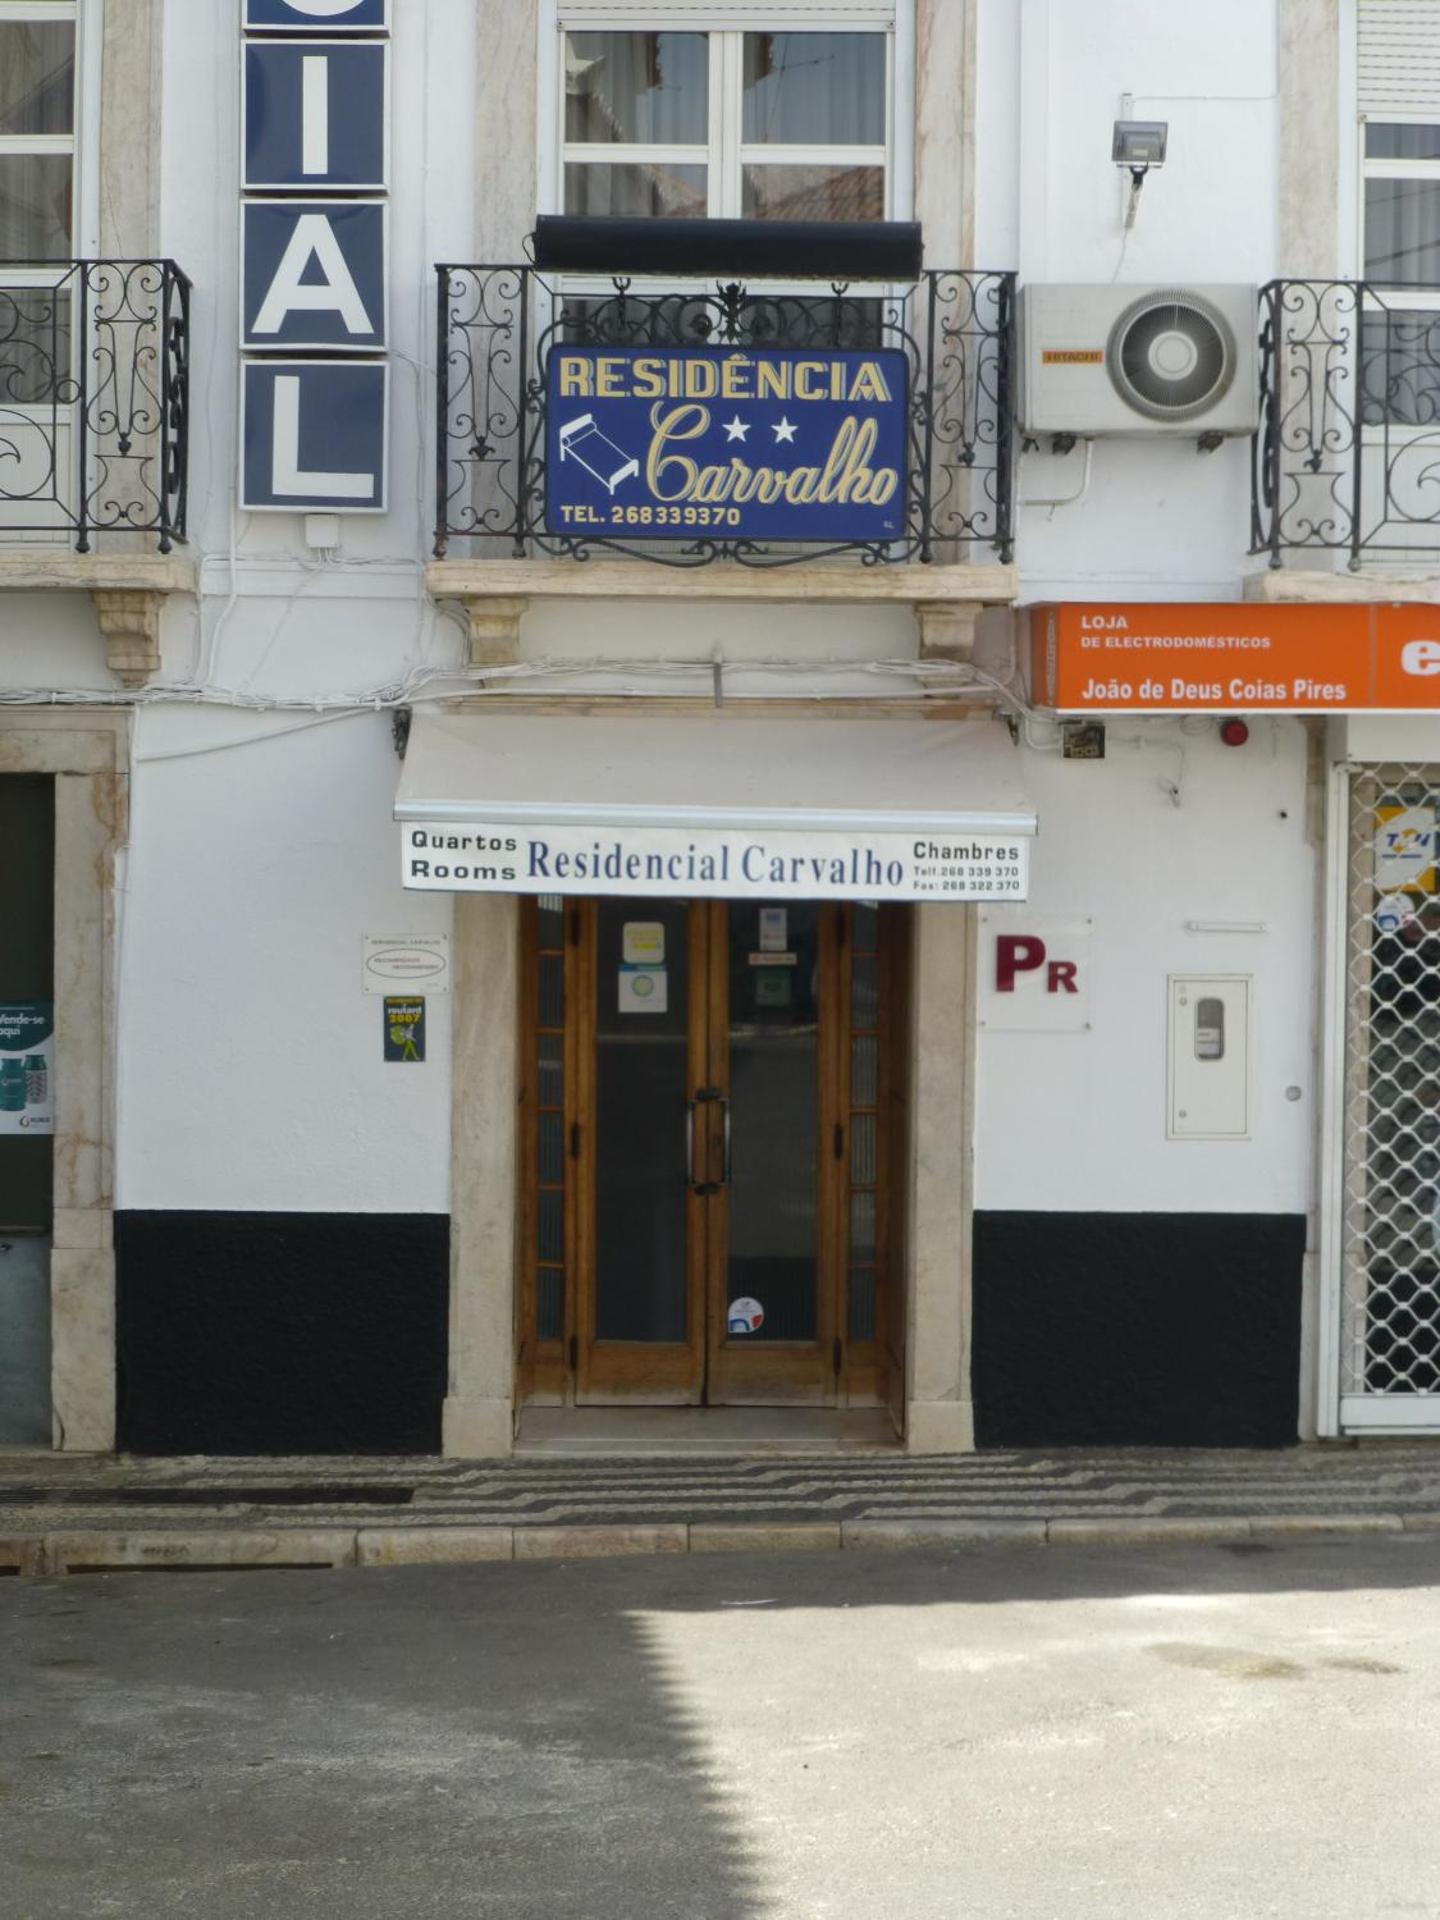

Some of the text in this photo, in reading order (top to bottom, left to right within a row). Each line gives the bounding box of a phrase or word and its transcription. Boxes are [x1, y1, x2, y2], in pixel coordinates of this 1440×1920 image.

[251, 0, 375, 499] IAL
[560, 353, 892, 402] RESIDÊNCIA
[646, 400, 898, 506] Carvalho
[560, 505, 605, 523] TEL.
[1081, 615, 1128, 629] LOJA
[1081, 636, 1101, 648] DE
[1082, 678, 1346, 700] João de Deus Coias Pires
[411, 830, 517, 851] Quartos
[913, 841, 1019, 860] Chambres
[411, 860, 516, 880] Rooms
[527, 841, 903, 887] Residencial Carvalho
[968, 867, 992, 877] 339
[995, 867, 1019, 877] 370
[942, 881, 966, 891] 268
[970, 881, 993, 891] 322
[997, 881, 1020, 891] 370
[389, 1014, 420, 1024] 2007
